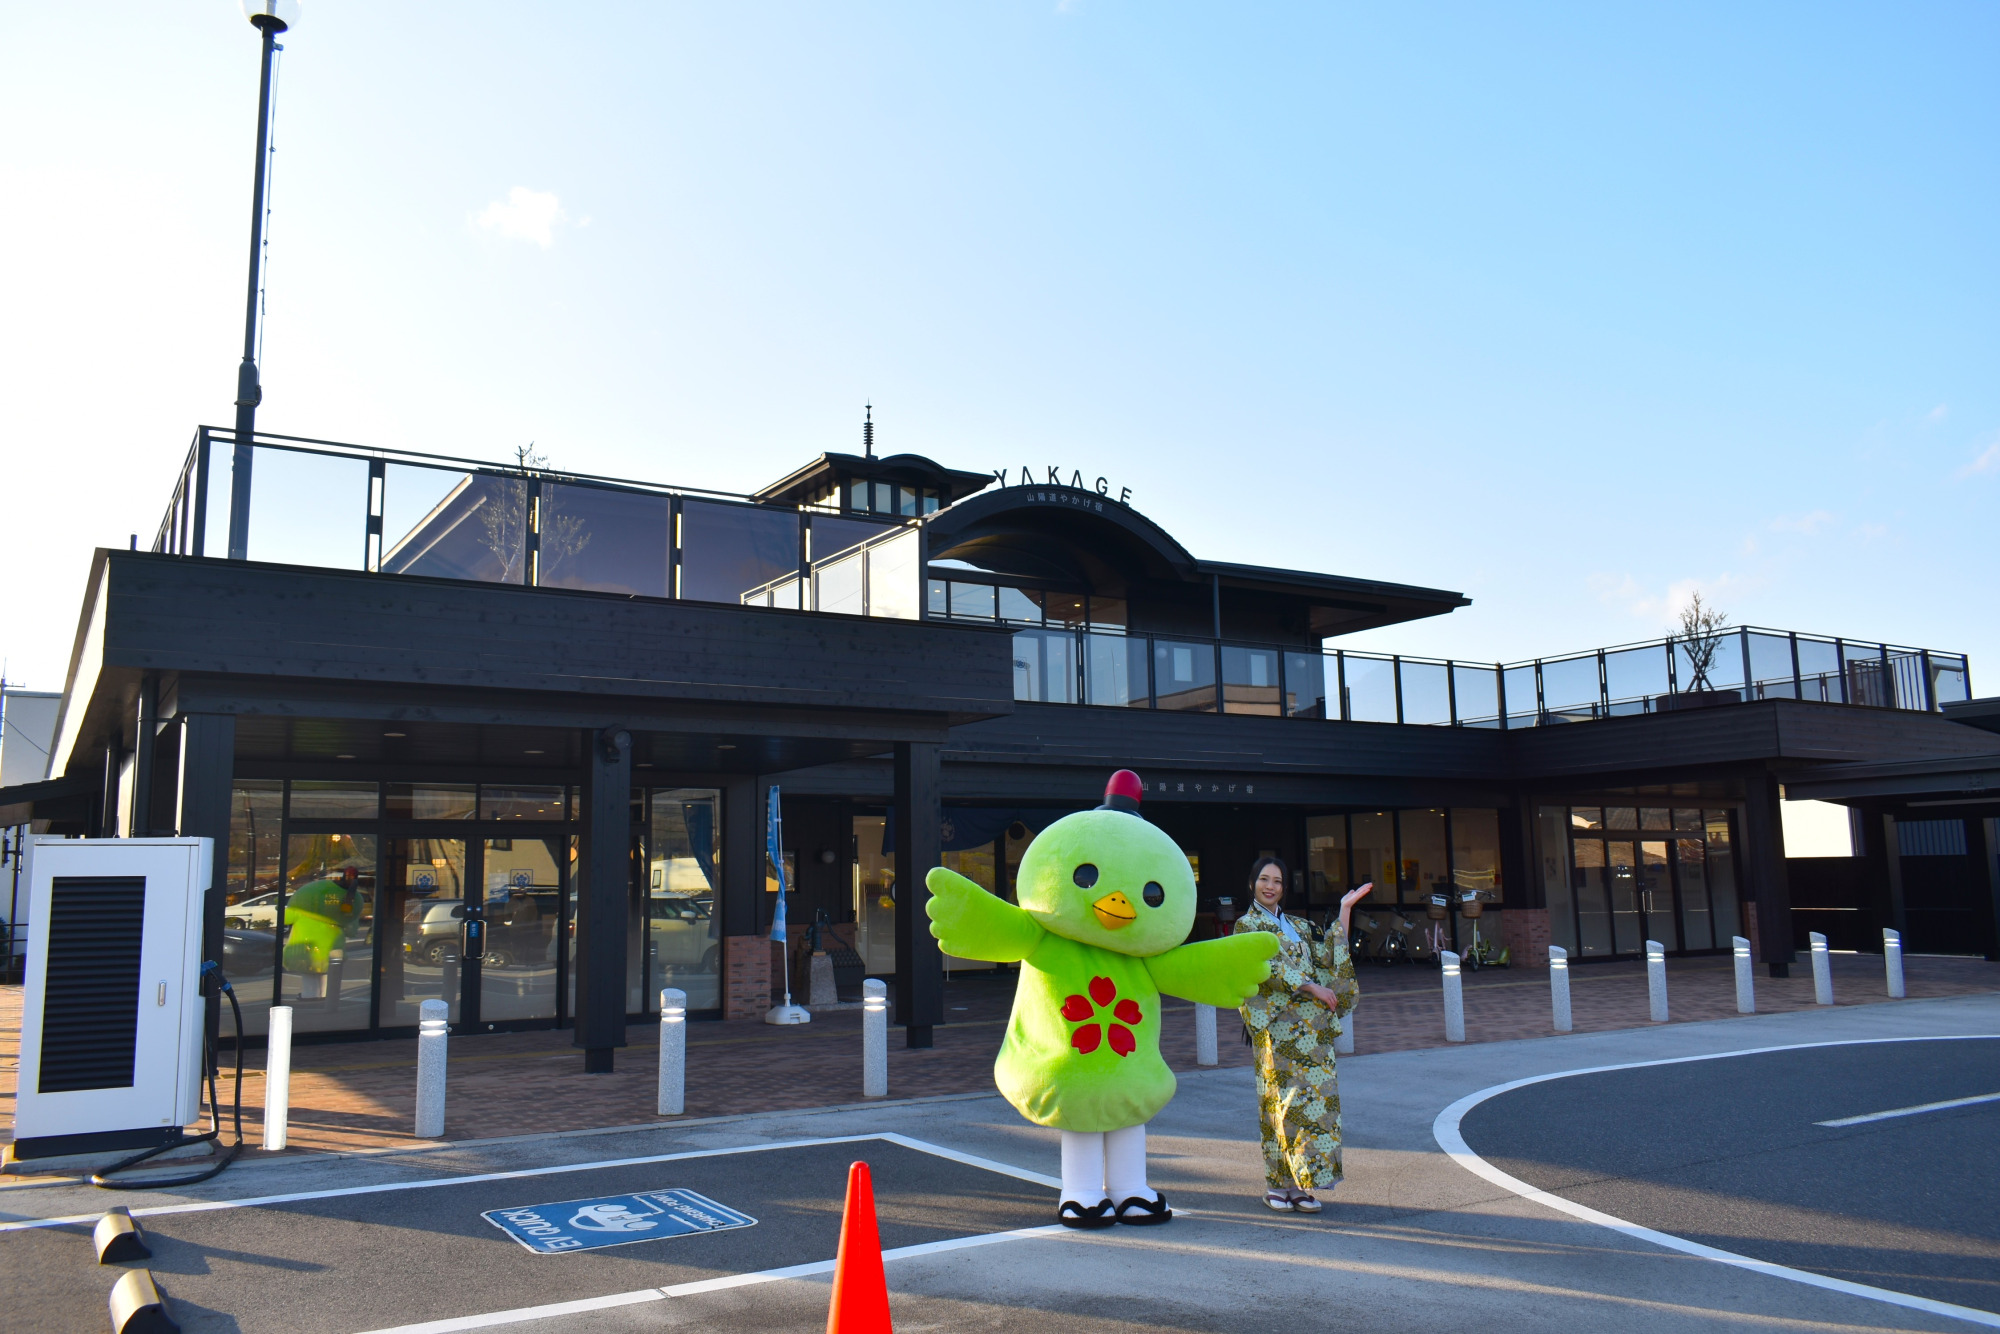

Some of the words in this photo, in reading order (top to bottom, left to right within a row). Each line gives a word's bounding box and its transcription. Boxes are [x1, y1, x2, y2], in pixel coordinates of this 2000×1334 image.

[993, 465, 1132, 506] YAKAGE
[1026, 492, 1103, 512] 山陽道やかげ宿
[650, 1194, 683, 1207] POINT
[500, 1208, 561, 1236] QUICK
[538, 1236, 583, 1249] EV
